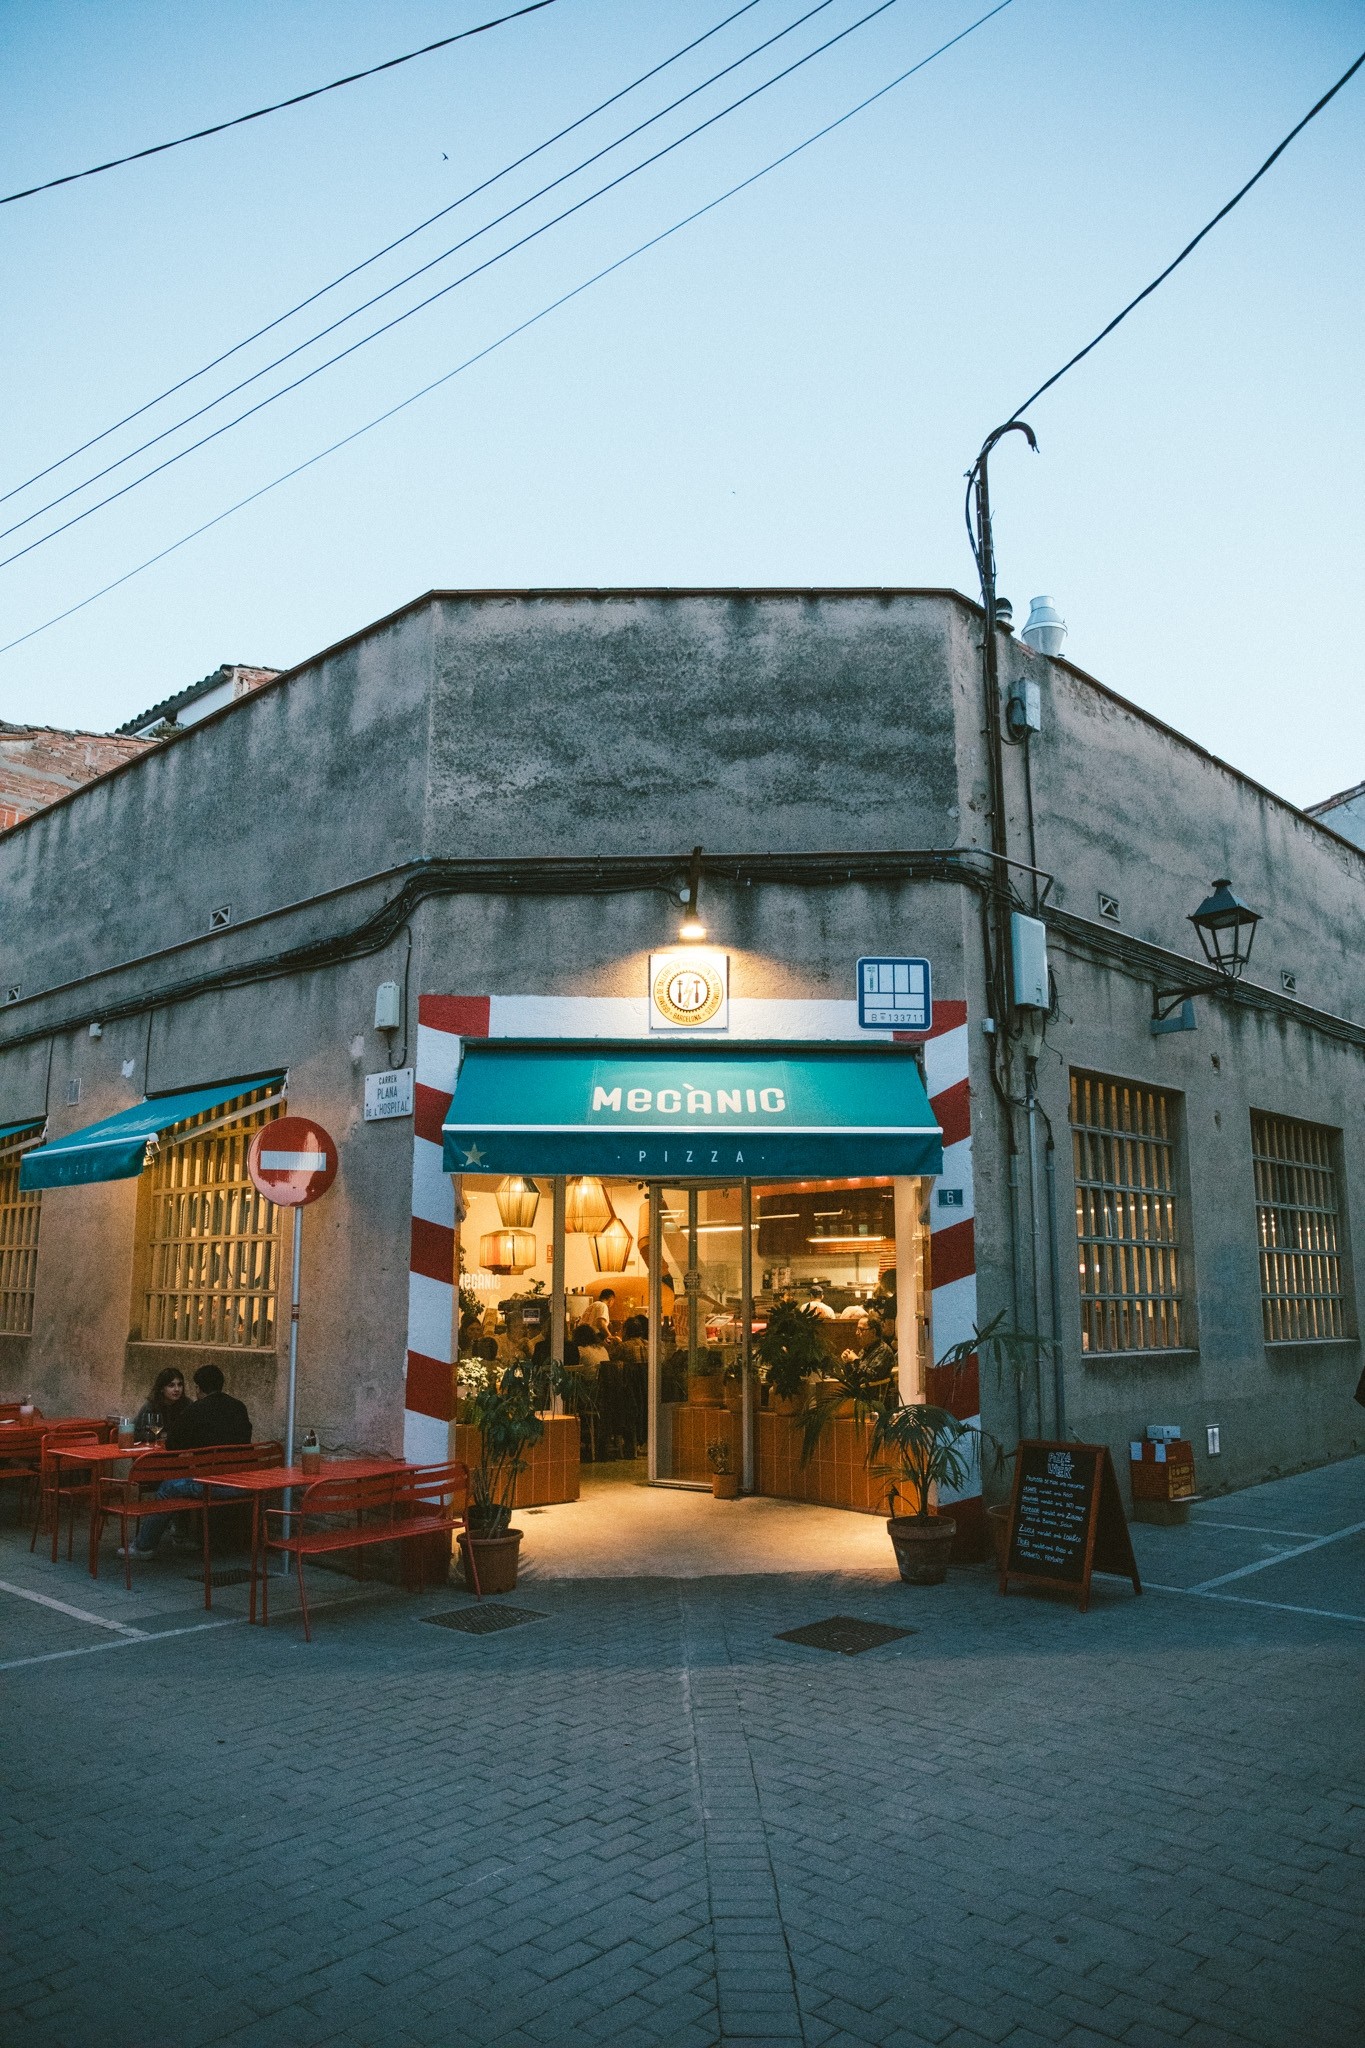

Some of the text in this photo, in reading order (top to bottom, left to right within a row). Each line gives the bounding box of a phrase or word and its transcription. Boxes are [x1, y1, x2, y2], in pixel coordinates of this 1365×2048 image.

[672, 1012, 702, 1023] BARCELONA
[378, 1074, 398, 1085] CARRER
[377, 1086, 398, 1100] PLANA
[366, 1108, 372, 1117] DE
[638, 1149, 746, 1163] PIZZA
[946, 1190, 954, 1204] 6
